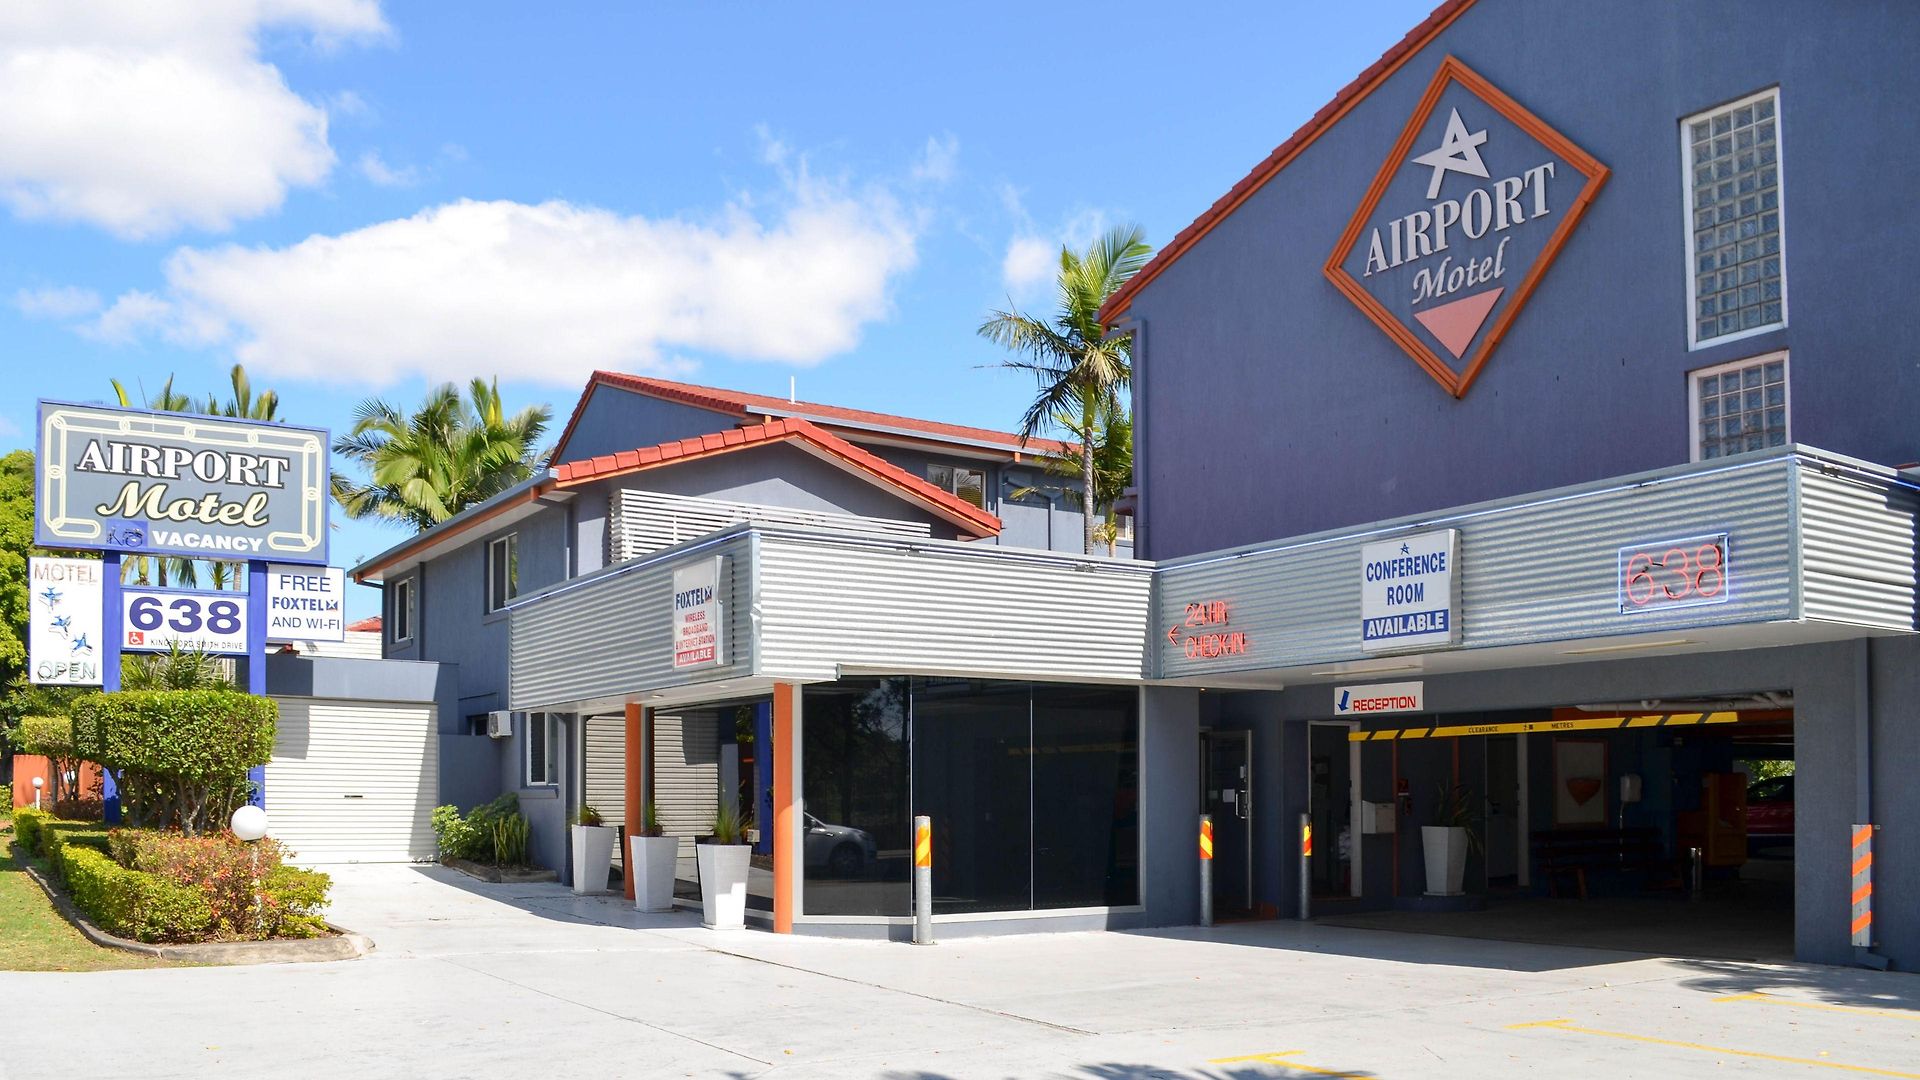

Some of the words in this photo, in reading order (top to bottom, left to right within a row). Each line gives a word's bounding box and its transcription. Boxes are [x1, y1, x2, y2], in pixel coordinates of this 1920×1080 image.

[1364, 162, 1554, 276] AIRPORT
[1412, 236, 1510, 304] Motel
[76, 439, 289, 488] AIRPORT
[96, 482, 269, 527] Motel
[152, 530, 263, 552] VACANCY
[34, 563, 97, 584] MOTEL
[1366, 551, 1446, 583] CONFERENCE
[1627, 544, 1722, 605] 638
[280, 574, 331, 592] FREE
[1387, 582, 1424, 605] ROOM
[272, 596, 324, 611] FOXTEL
[675, 588, 706, 610] FOXTEL
[129, 597, 242, 634] 638
[272, 616, 302, 628] AND
[306, 618, 340, 630] WI-FI
[684, 611, 706, 623] WIRELESS
[1366, 611, 1445, 638] AVAILABLE
[682, 623, 708, 636] BROADBAND
[221, 641, 243, 650] DRIVE
[679, 637, 698, 649] INTERNET
[699, 634, 715, 645] STATION
[679, 649, 712, 663] AVAILABLE
[37, 661, 96, 682] OPEN
[1353, 695, 1416, 712] RECEPTION
[1468, 726, 1498, 734] CLEARANCE
